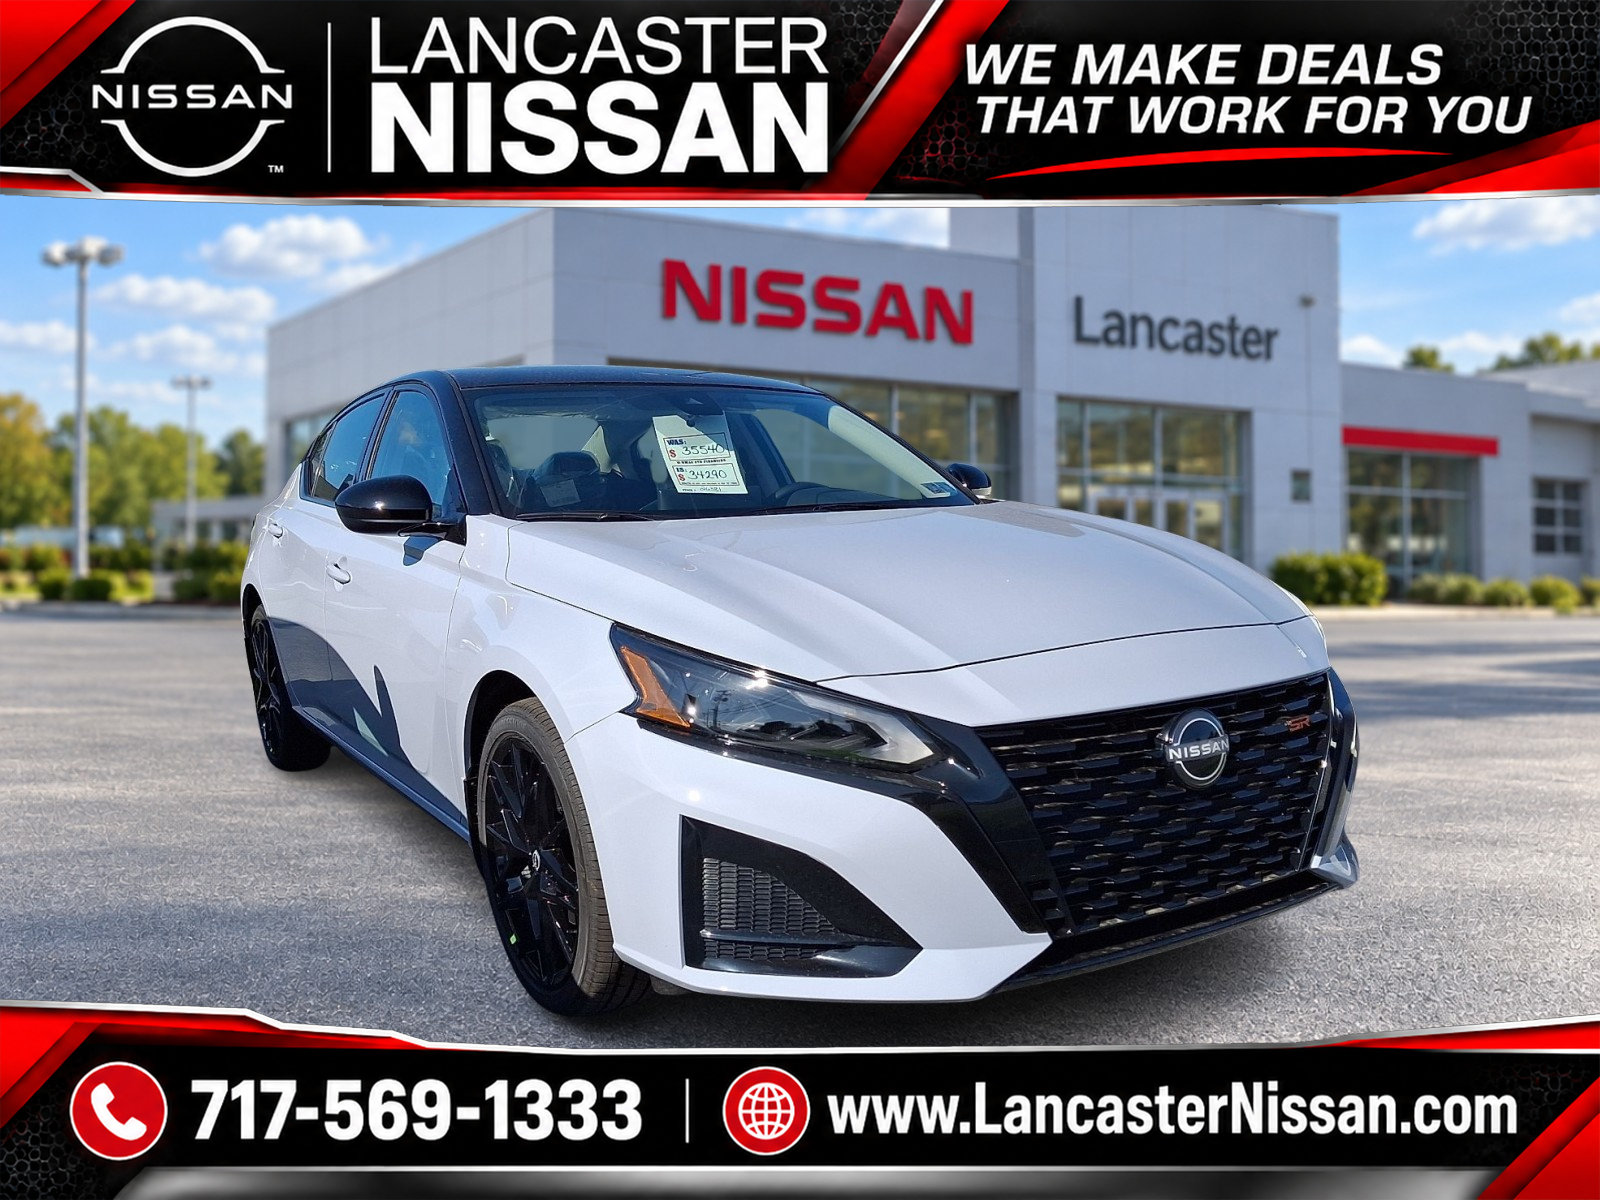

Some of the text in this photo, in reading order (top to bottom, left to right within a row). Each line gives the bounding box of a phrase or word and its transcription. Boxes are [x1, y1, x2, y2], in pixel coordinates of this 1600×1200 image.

[662, 258, 975, 345] NISSAN
[1073, 296, 1279, 362] Lancaster
[682, 444, 725, 455] 35540
[688, 469, 727, 479] 34290
[1168, 739, 1229, 760] NISSAN
